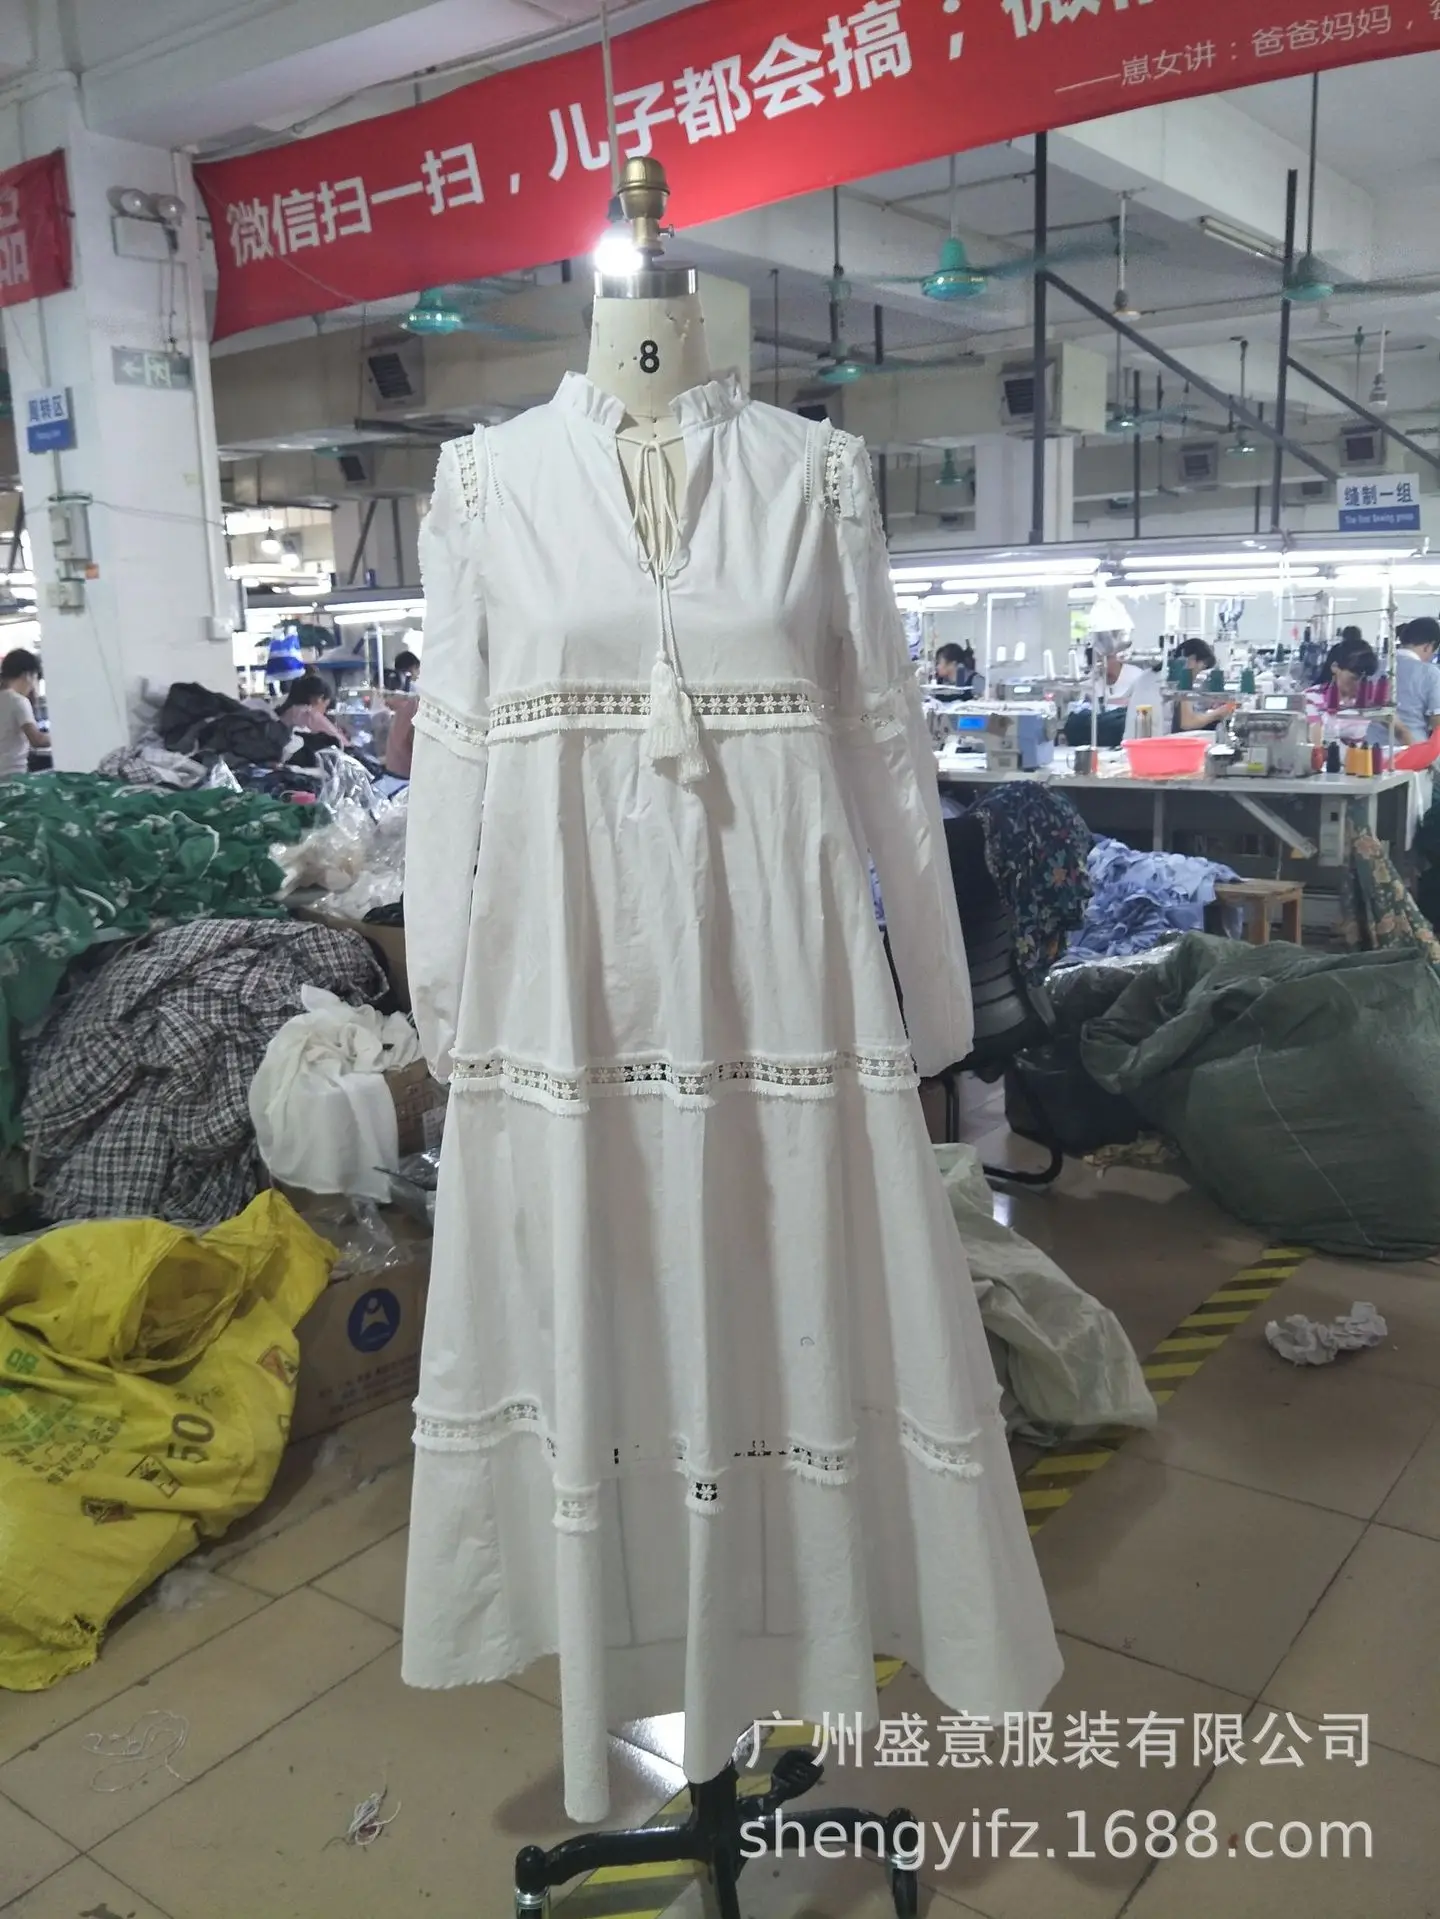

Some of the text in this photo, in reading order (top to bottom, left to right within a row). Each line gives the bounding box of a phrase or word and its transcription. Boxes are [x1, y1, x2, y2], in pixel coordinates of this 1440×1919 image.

[226, 0, 1155, 268] 微信扫一扫，儿子都会搞；
[640, 339, 660, 374] 8
